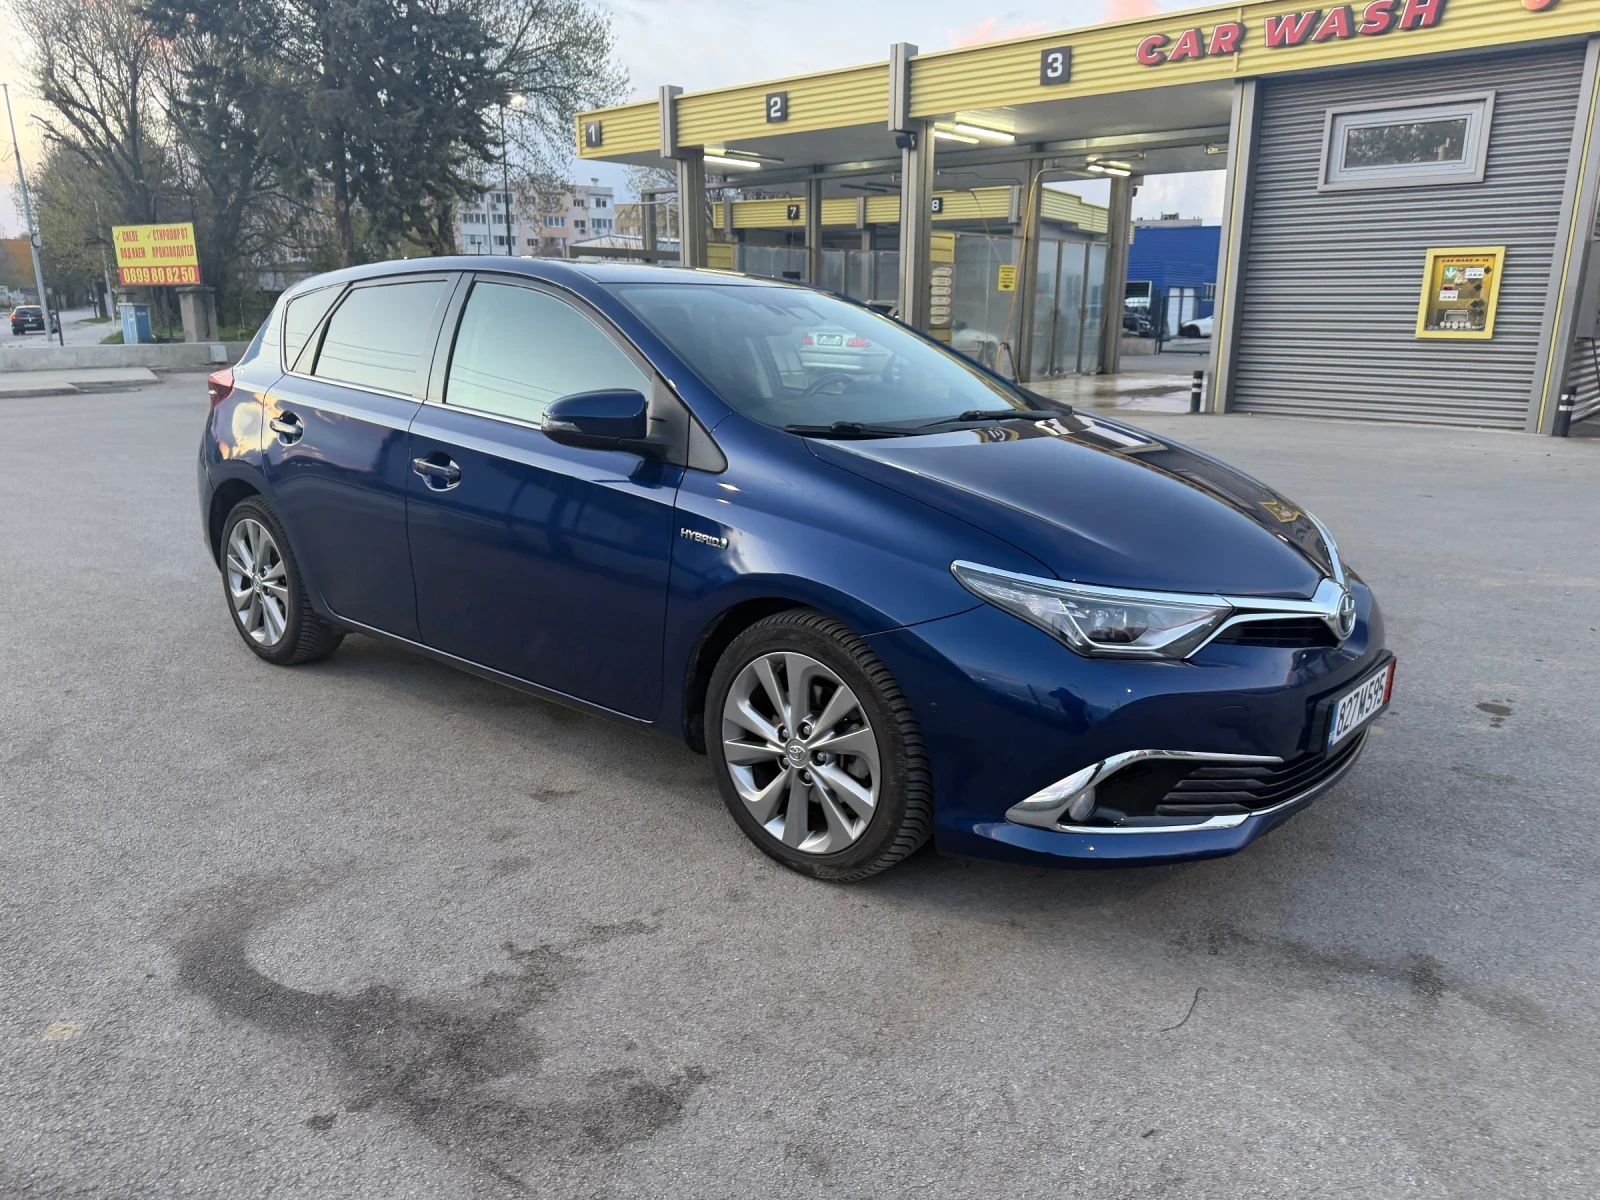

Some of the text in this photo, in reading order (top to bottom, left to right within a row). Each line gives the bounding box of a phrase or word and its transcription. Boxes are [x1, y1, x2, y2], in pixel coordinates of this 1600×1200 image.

[1135, 0, 1445, 66] CAR WASH
[1046, 52, 1063, 78] 3
[770, 96, 782, 118] 2
[588, 124, 596, 143] 1
[789, 206, 797, 217] 7
[931, 199, 940, 211] 8
[123, 267, 195, 283] 0899 80 82 50
[680, 527, 720, 547] HYBRID
